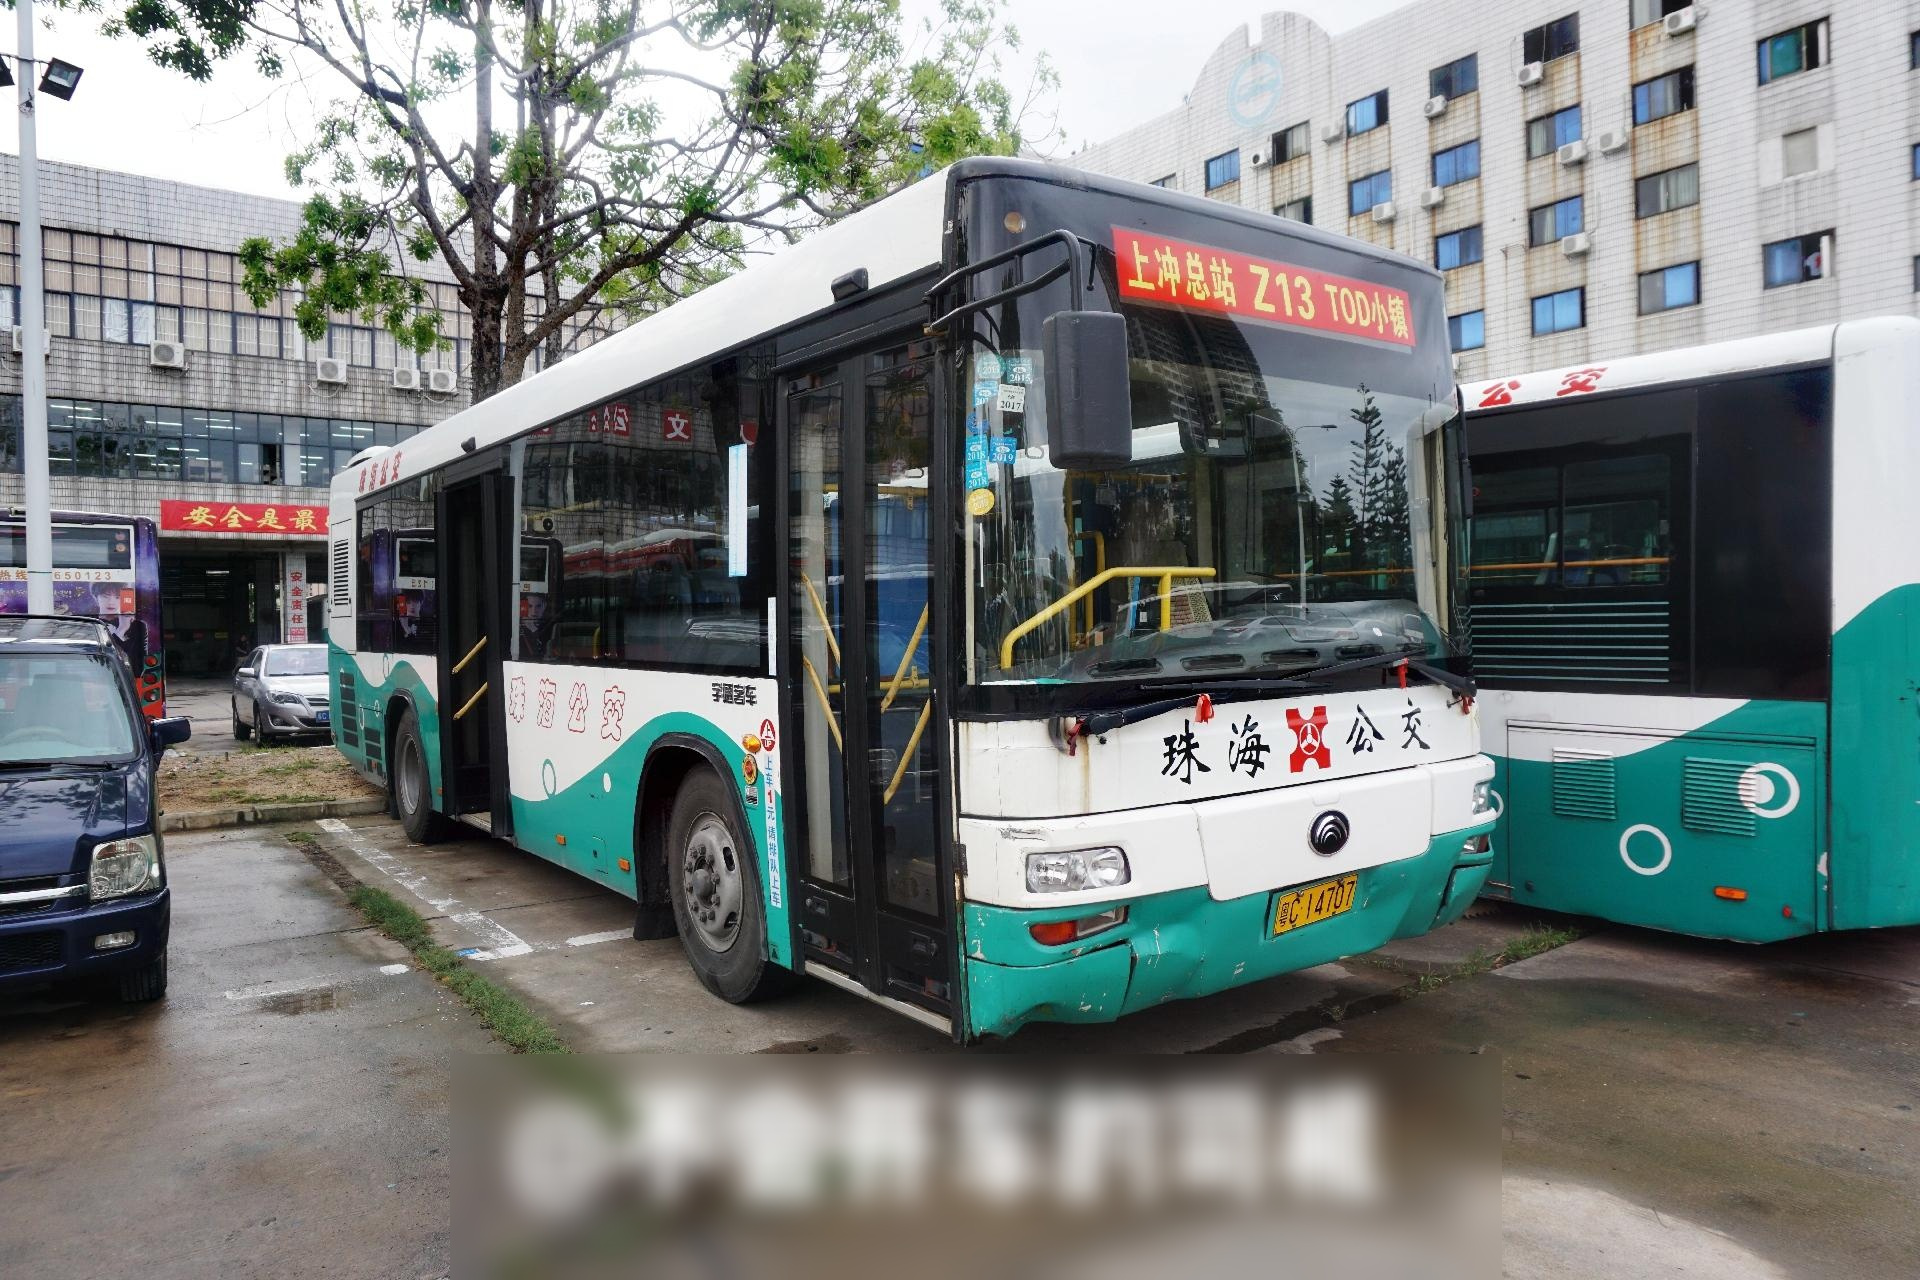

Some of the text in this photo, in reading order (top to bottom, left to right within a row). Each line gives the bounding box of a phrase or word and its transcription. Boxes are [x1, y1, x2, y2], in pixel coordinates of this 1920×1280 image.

[1129, 240, 1409, 339] 上冲总站 Z13 TOD小镇
[1479, 367, 1607, 407] 公交
[1000, 400, 1021, 410] 2017
[992, 453, 1014, 462] 2019
[183, 505, 329, 531] 安全是最
[711, 683, 757, 706] 宇通客车
[1161, 697, 1430, 785] 珠海 公交
